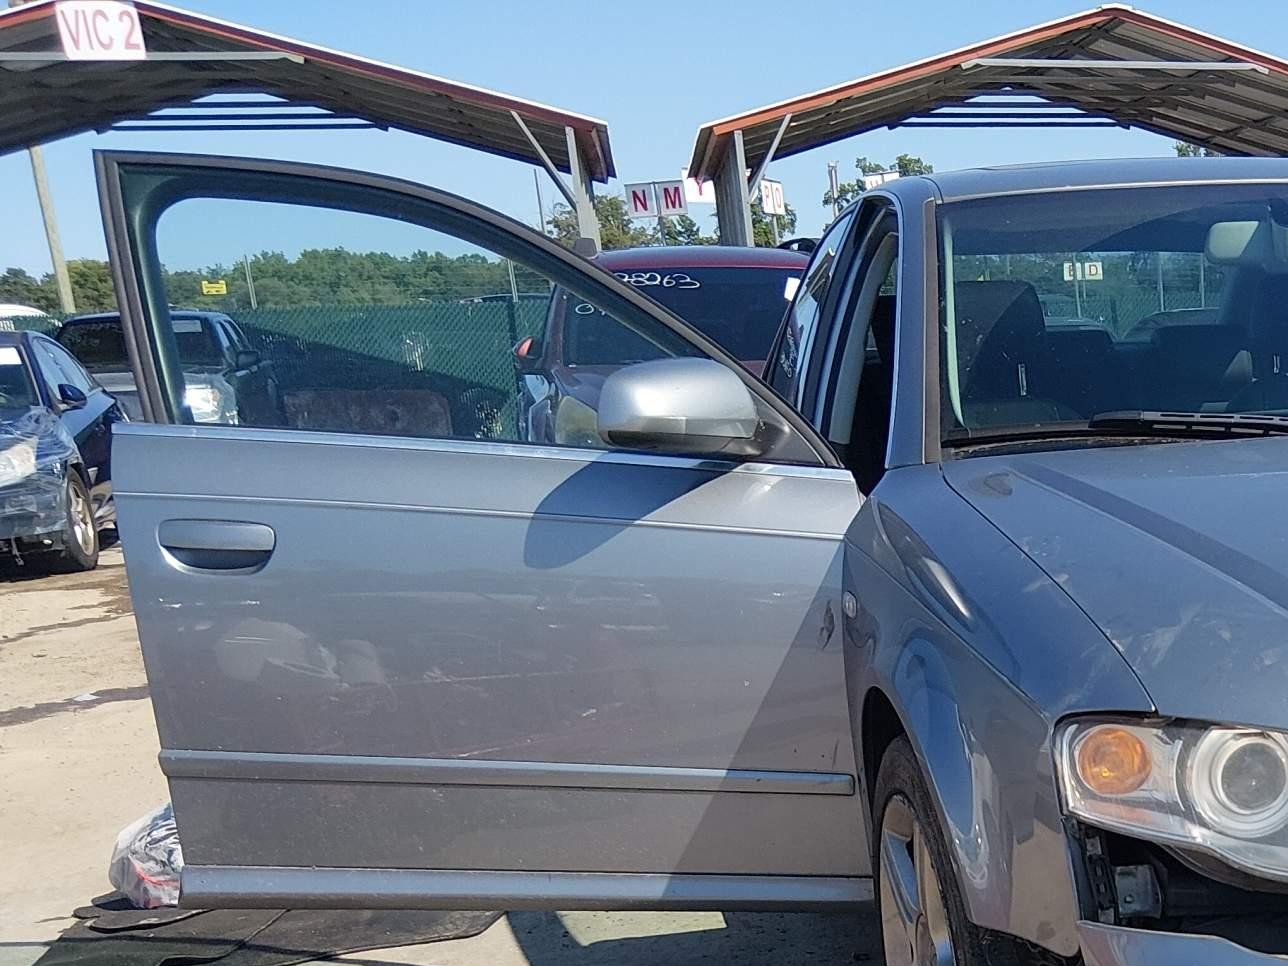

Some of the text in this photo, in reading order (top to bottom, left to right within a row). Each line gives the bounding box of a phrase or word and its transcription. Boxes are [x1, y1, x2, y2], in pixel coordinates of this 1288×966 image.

[60, 9, 142, 51] VIC 2
[631, 186, 683, 213] N M
[1088, 263, 1099, 277] D
